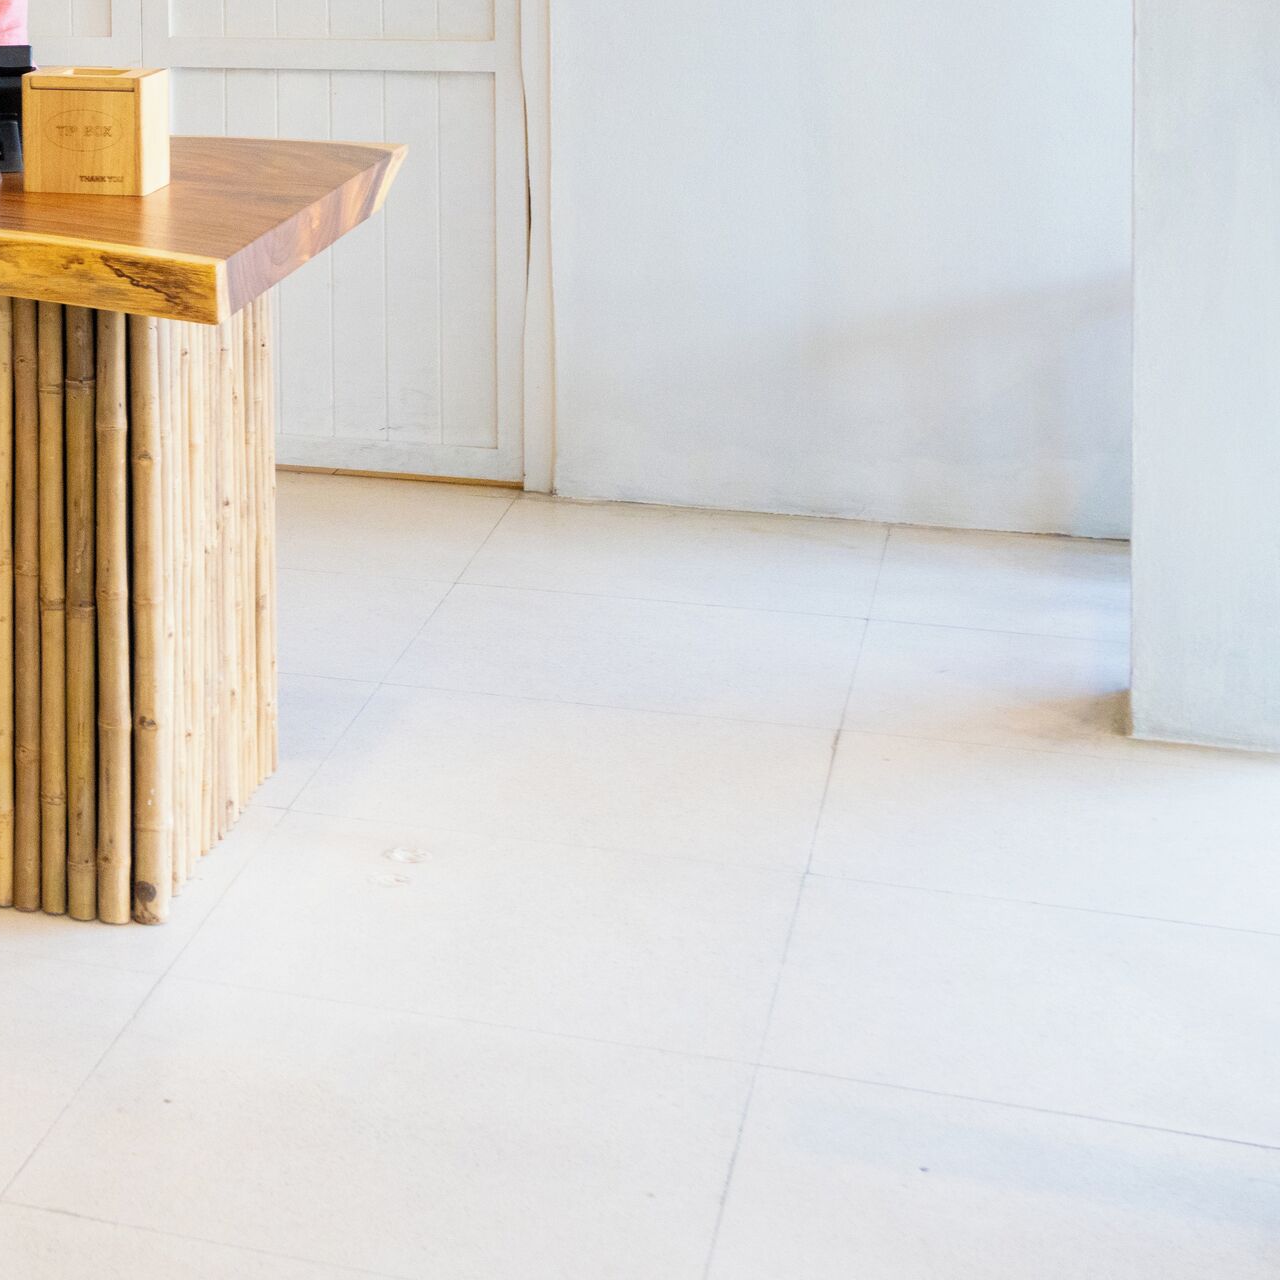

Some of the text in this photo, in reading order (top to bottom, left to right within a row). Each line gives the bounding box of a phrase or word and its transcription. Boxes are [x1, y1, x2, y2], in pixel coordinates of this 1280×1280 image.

[56, 126, 113, 137] TIP BOX
[79, 175, 106, 183] THANK
